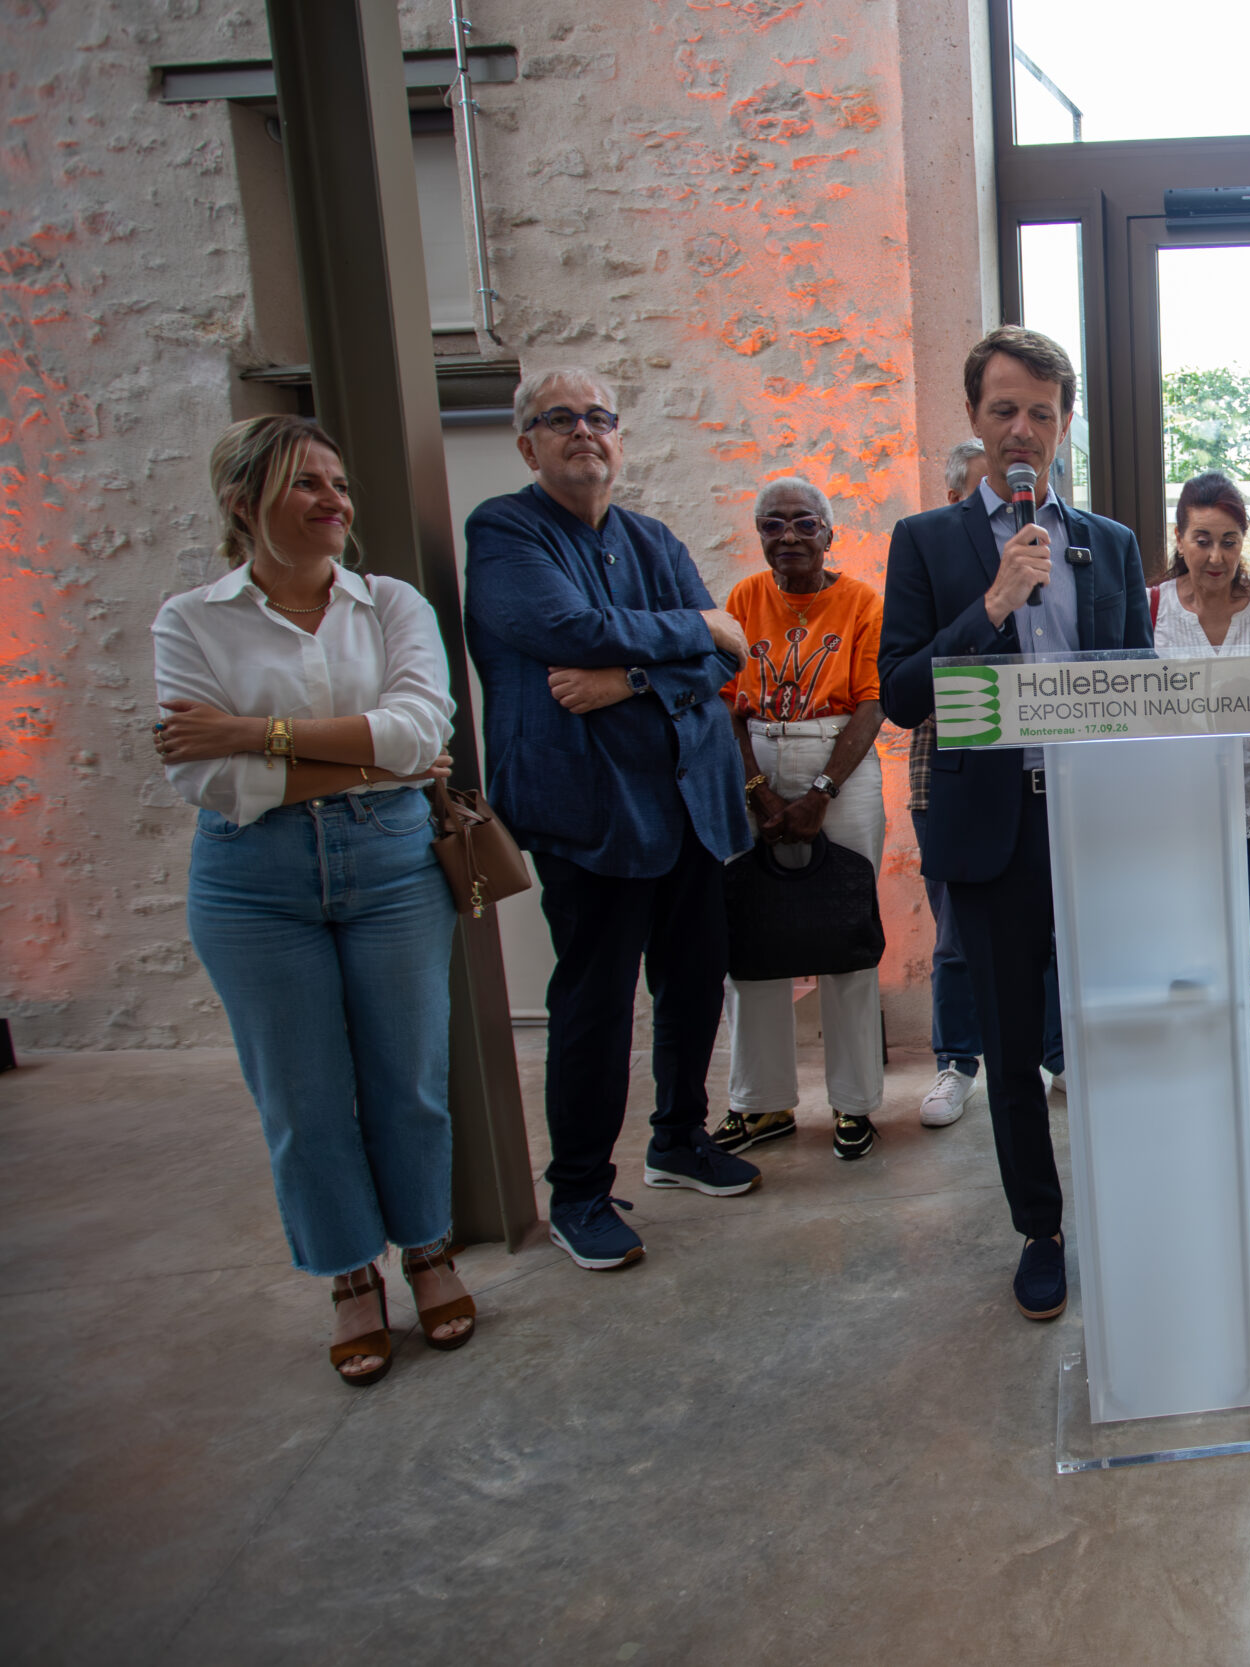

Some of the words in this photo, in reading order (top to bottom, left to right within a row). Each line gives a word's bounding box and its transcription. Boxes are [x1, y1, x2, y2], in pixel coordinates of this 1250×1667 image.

[1017, 665, 1201, 698] HalleBernier
[1018, 701, 1137, 721] EXPOSITION
[1019, 726, 1075, 737] Montereau
[1085, 723, 1129, 734] 17.09.26
